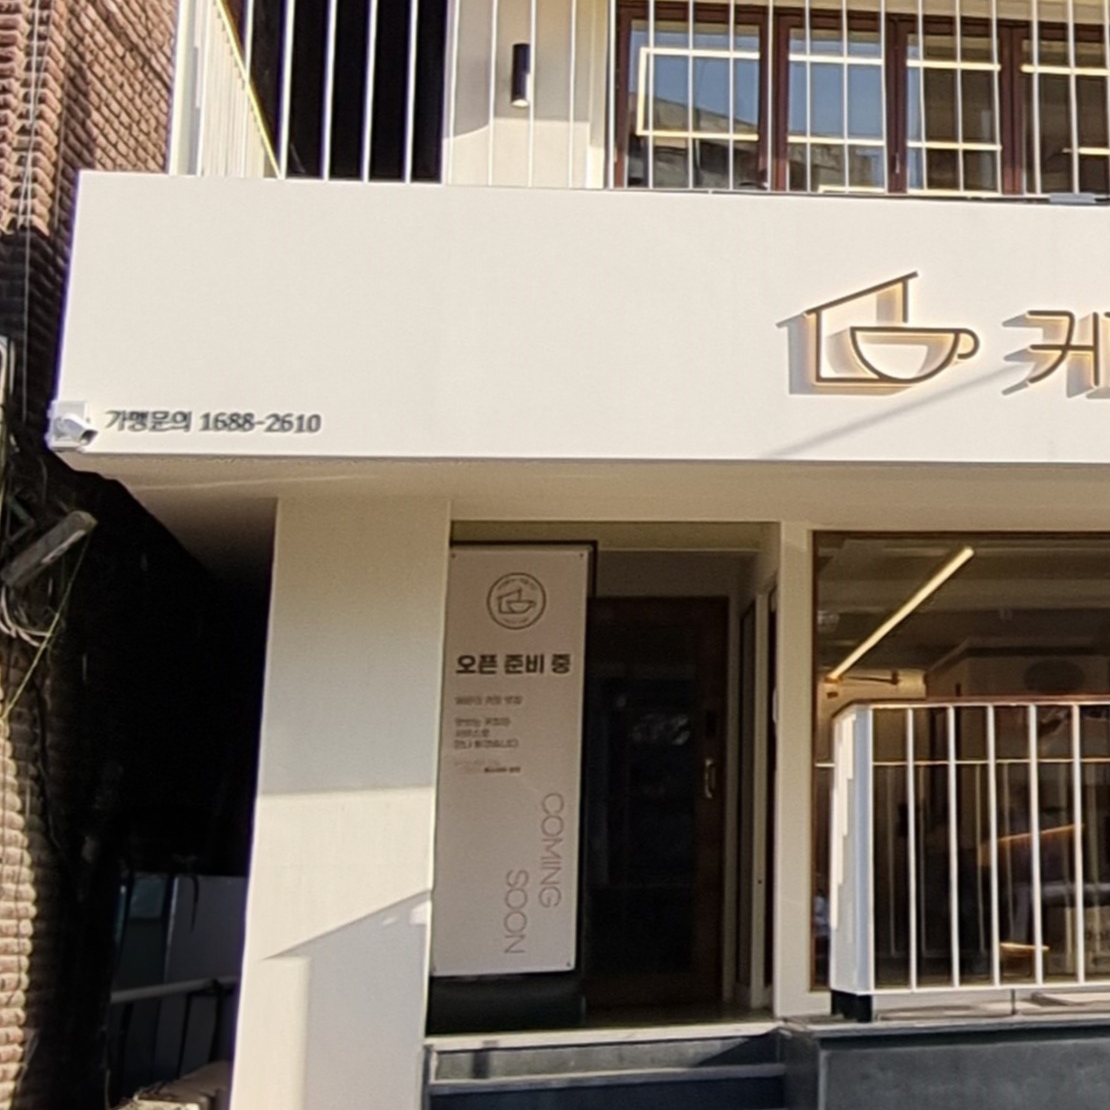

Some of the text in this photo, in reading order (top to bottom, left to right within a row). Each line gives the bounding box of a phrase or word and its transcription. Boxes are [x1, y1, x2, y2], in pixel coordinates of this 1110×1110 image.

[105, 409, 322, 434] 가맹문의 1688-2610
[455, 653, 571, 675] 오픈 준비 중
[538, 792, 565, 908] COMING
[503, 869, 530, 954] SOON
